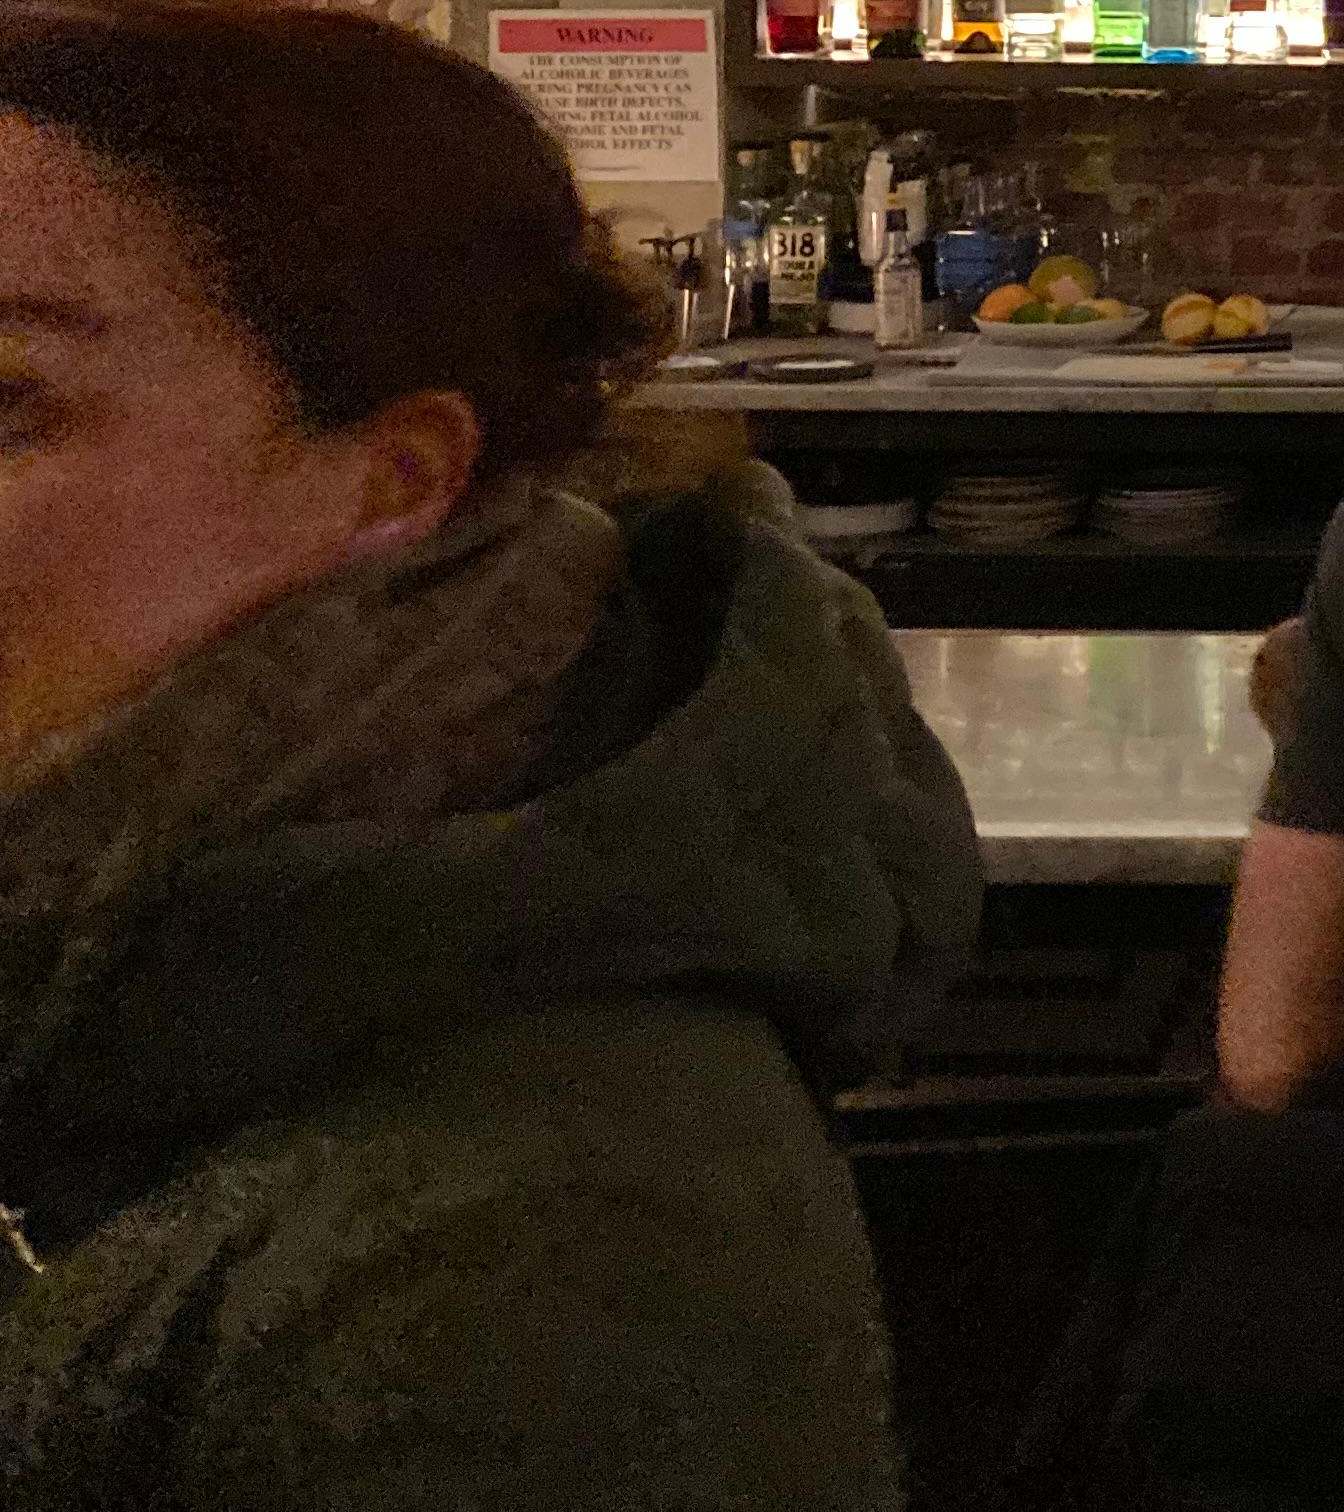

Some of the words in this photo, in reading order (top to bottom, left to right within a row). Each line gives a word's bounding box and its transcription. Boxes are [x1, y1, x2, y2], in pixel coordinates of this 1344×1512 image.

[556, 27, 654, 44] WARNING
[529, 55, 556, 66] THE
[663, 55, 683, 66] OF
[663, 82, 693, 94] CAN
[534, 96, 568, 107] AUSE
[610, 124, 639, 136] AND
